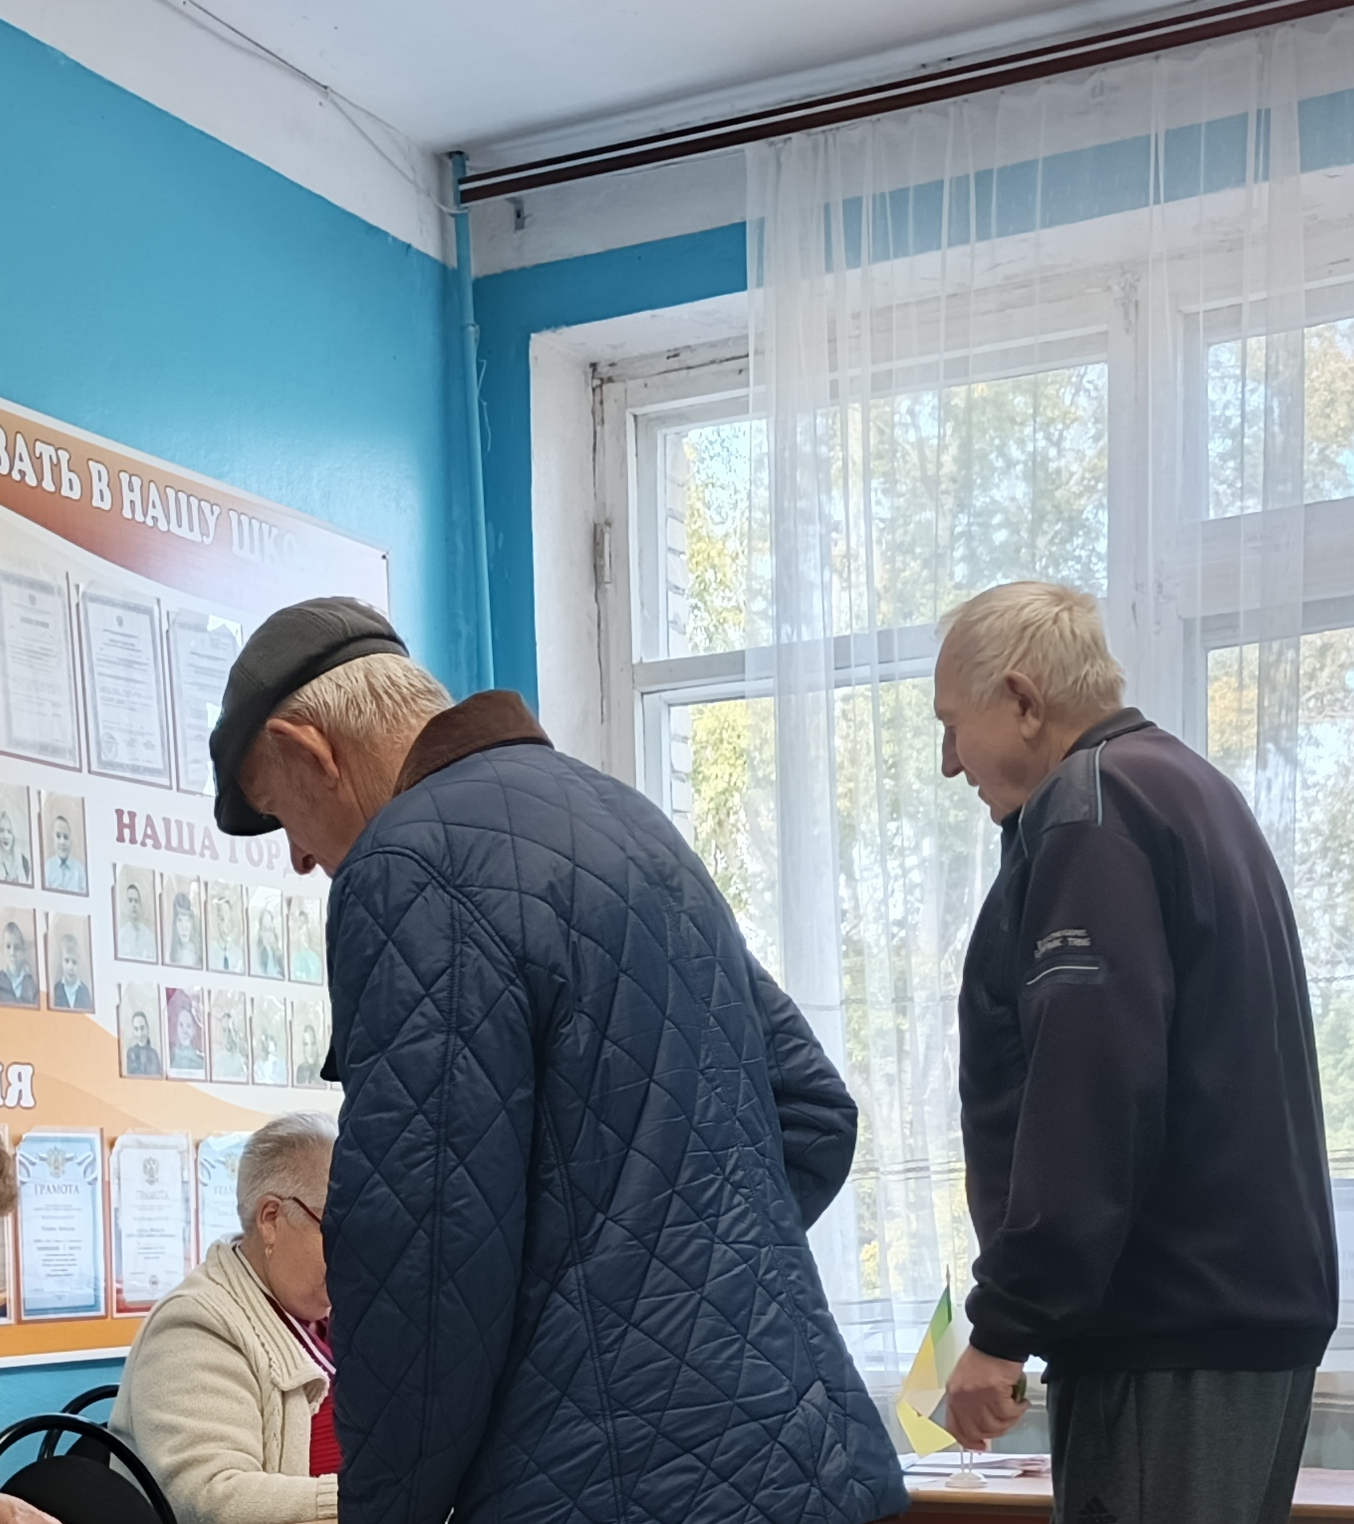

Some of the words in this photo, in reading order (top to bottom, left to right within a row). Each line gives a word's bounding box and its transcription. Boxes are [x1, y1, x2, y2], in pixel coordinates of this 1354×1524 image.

[87, 458, 113, 511] В
[118, 470, 221, 546] НАШУ
[228, 509, 298, 566] ШКО
[115, 808, 220, 861] НАША
[34, 1184, 80, 1196] ГРАМОТА
